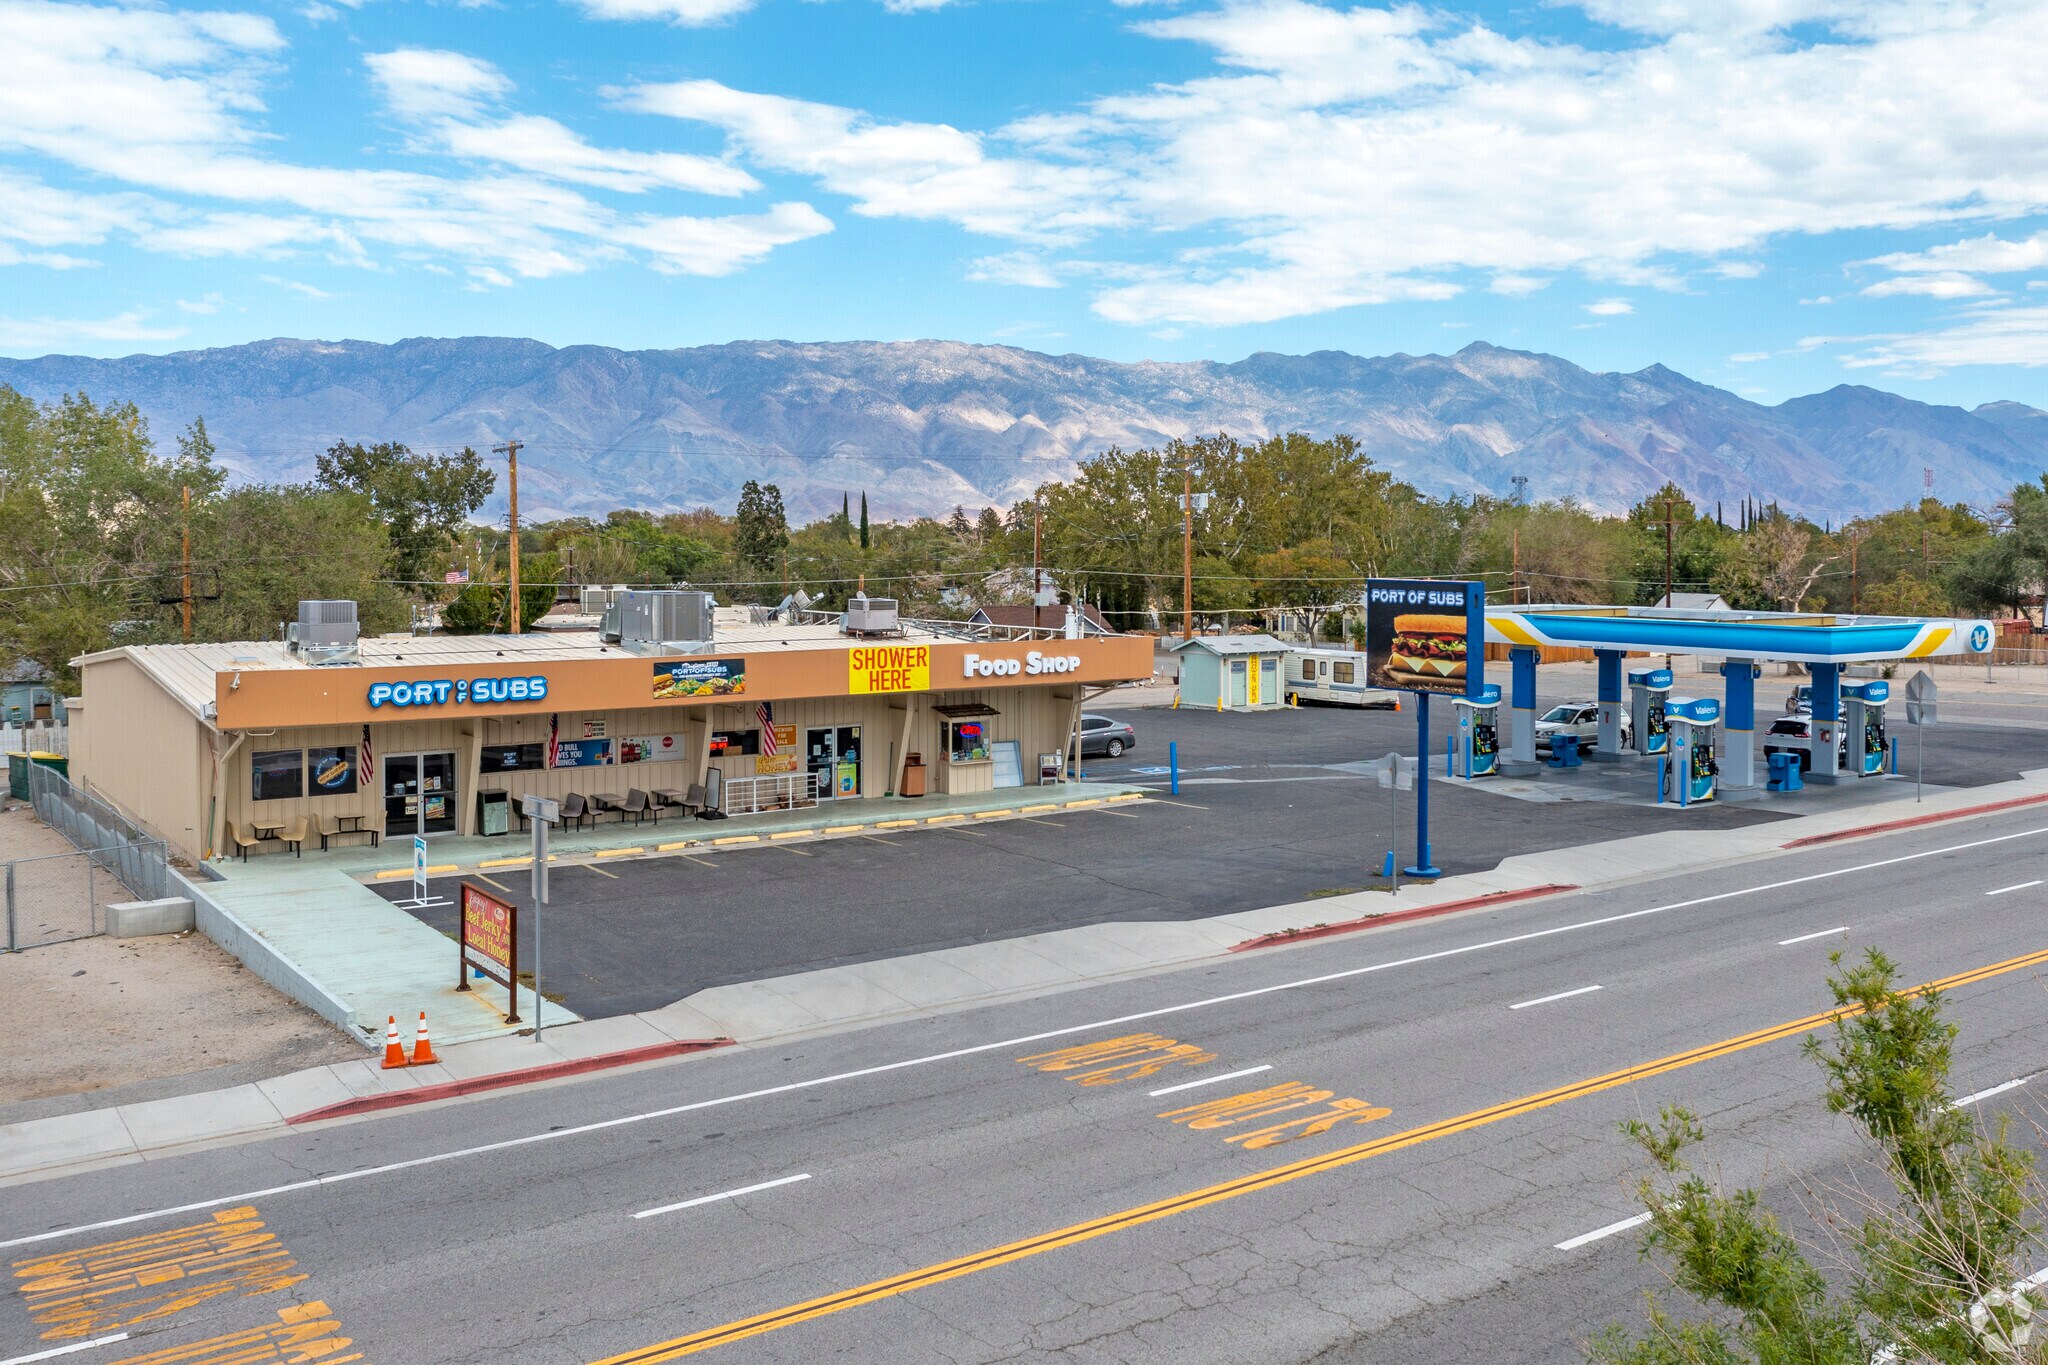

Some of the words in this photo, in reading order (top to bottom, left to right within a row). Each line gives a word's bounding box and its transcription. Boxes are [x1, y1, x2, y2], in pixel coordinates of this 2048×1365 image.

[1371, 588, 1406, 604] PORT
[1407, 590, 1425, 605] OF
[1428, 590, 1464, 606] SUBS
[852, 647, 928, 671] SHOWER
[963, 654, 1021, 677] FOOD
[1025, 651, 1081, 675] SHOP
[671, 667, 693, 675] PORT
[868, 668, 912, 691] HERE
[1651, 674, 1671, 683] Valero
[369, 681, 451, 707] PORT
[456, 680, 468, 705] OF
[472, 677, 546, 703] SUBS
[1480, 690, 1498, 698] alero
[1868, 687, 1887, 696] Valero
[1695, 706, 1717, 715] Valero
[584, 723, 592, 736] NO
[960, 724, 982, 736] OPEN
[564, 743, 578, 751] BULL
[558, 751, 569, 759] VES
[569, 750, 583, 758] YOU
[759, 756, 776, 764] Pure
[758, 762, 789, 773] HONEY
[469, 892, 488, 913] Enjoy!
[465, 904, 480, 926] Beef
[481, 911, 502, 942] Jerky
[468, 924, 486, 950] Local
[487, 936, 510, 967] Honey
[1015, 1032, 1217, 1086] SLOW
[1156, 1080, 1393, 1150] SLOW
